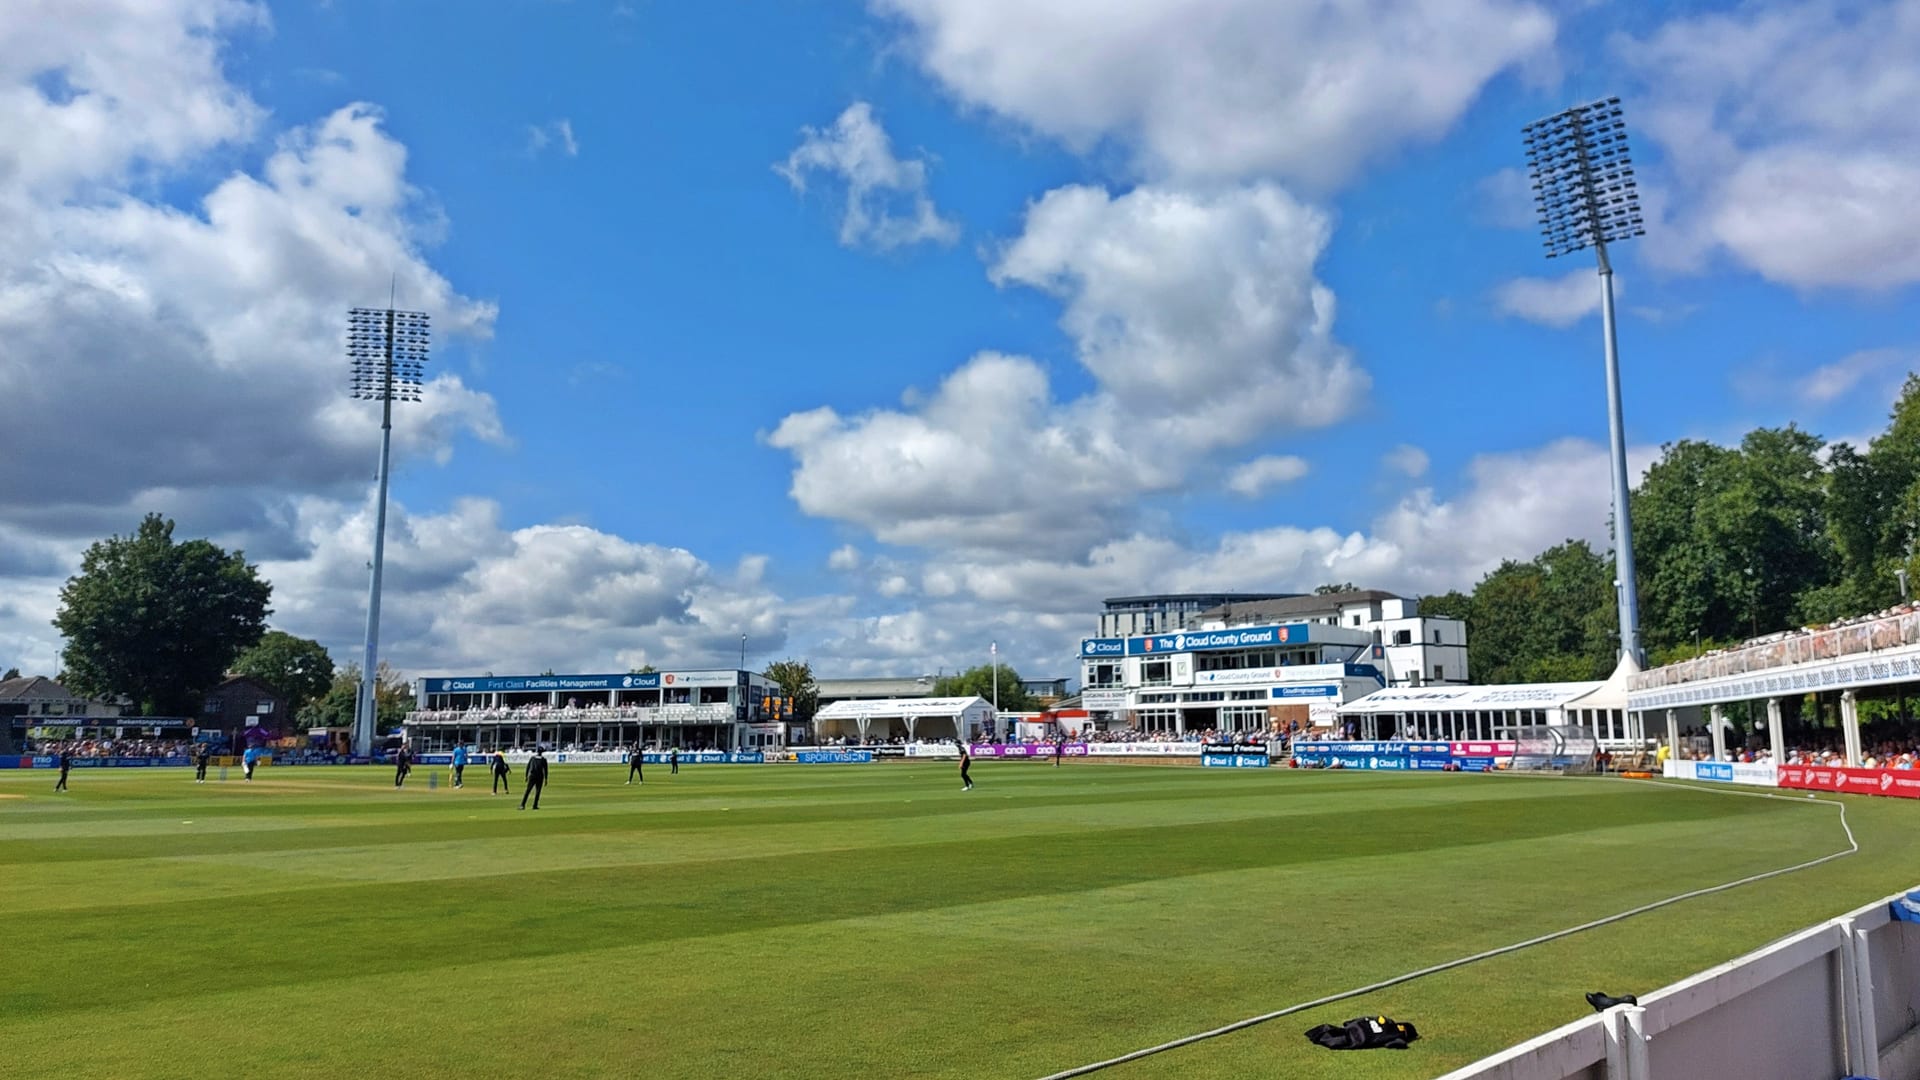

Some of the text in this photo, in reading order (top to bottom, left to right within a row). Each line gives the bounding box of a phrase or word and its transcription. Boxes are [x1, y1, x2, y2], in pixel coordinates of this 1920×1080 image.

[1159, 632, 1272, 649] The Cloud County Ground
[1097, 643, 1121, 651] Cloud
[452, 681, 475, 689] Cloud
[488, 681, 504, 689] First
[525, 680, 558, 688] Facilities
[559, 679, 608, 688] Management
[633, 677, 656, 686] Cloud
[1378, 759, 1398, 767] Cloud
